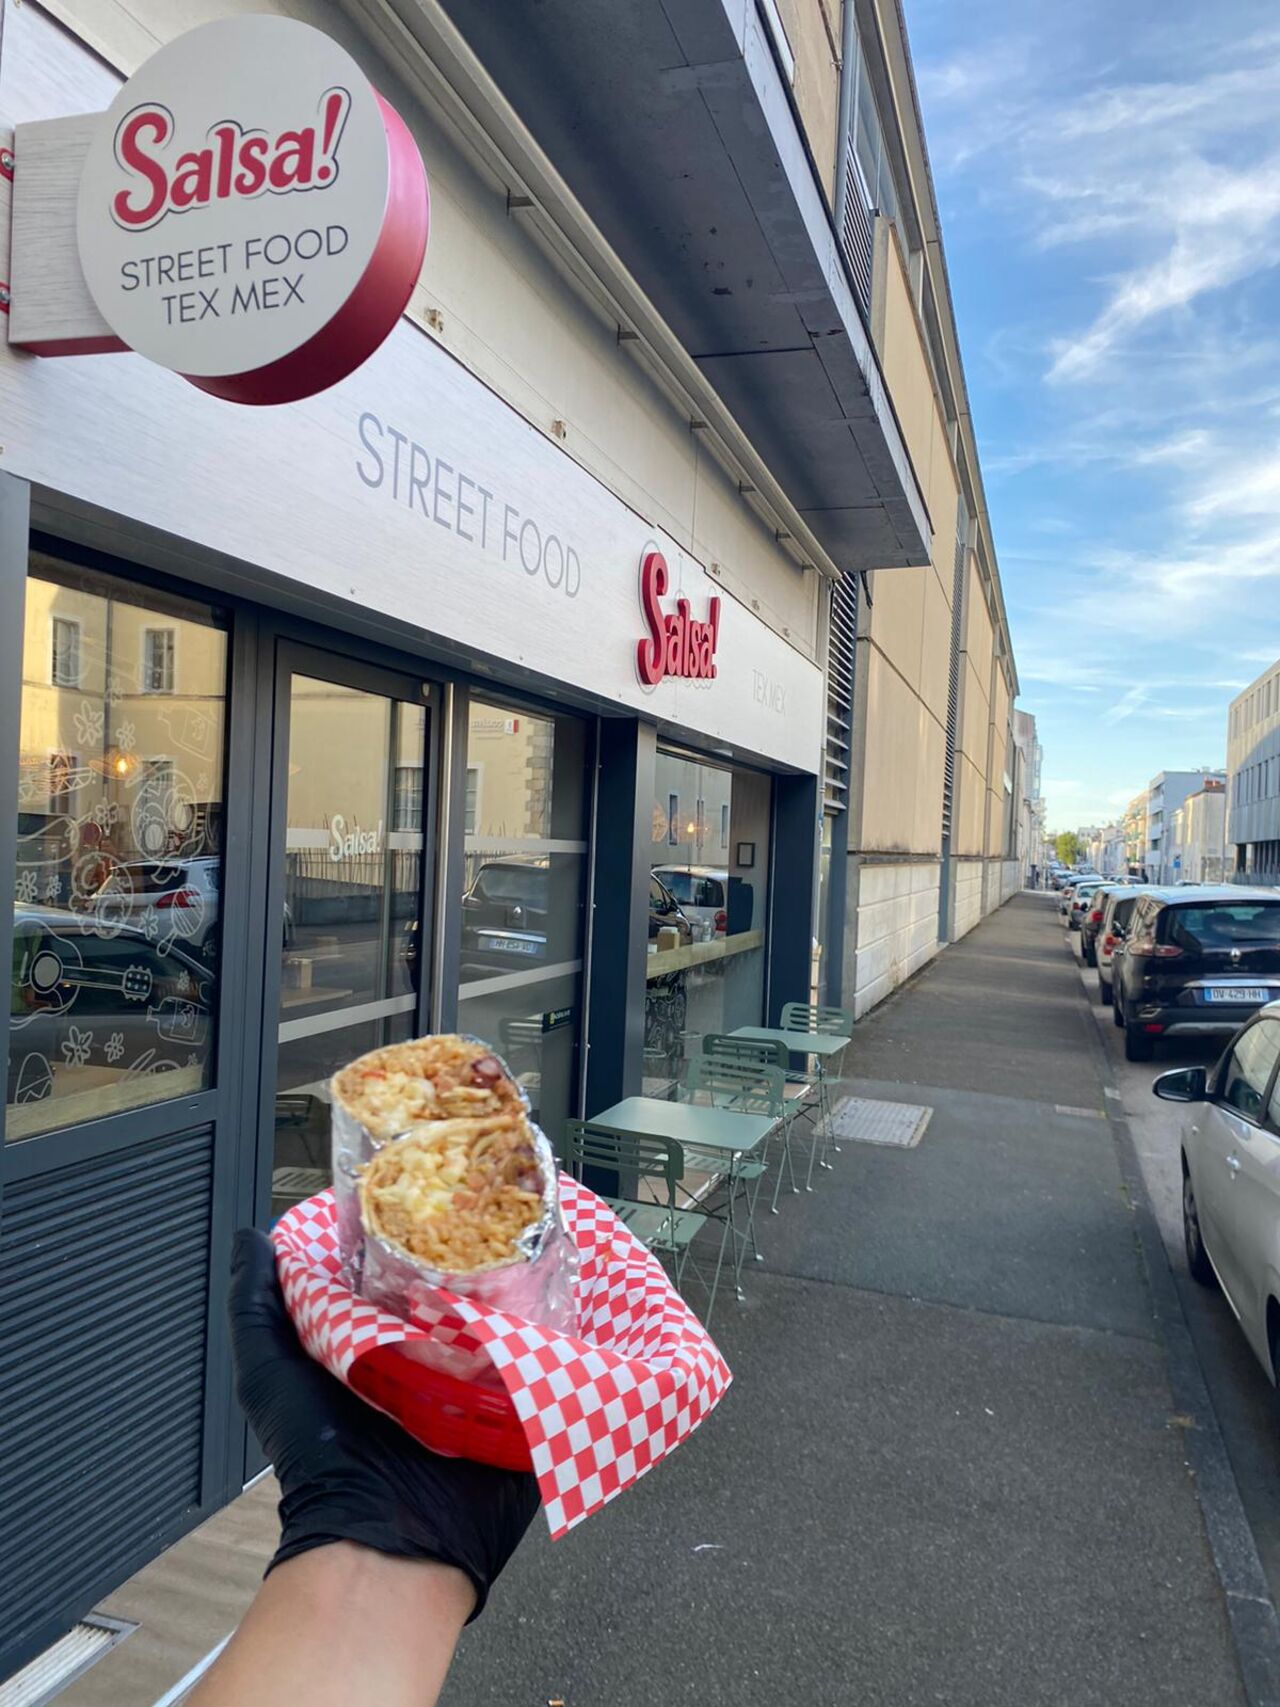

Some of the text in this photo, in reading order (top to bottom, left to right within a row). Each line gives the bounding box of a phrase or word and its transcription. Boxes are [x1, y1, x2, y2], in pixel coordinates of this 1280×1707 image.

[113, 92, 343, 226] Salsa!
[120, 225, 349, 291] STREET FOOD
[162, 274, 306, 325] TEX MEX
[356, 412, 582, 599] STREET FOOD
[637, 551, 722, 686] Salsa!
[752, 668, 788, 717] TEX MEX
[330, 814, 383, 861] Salsa!
